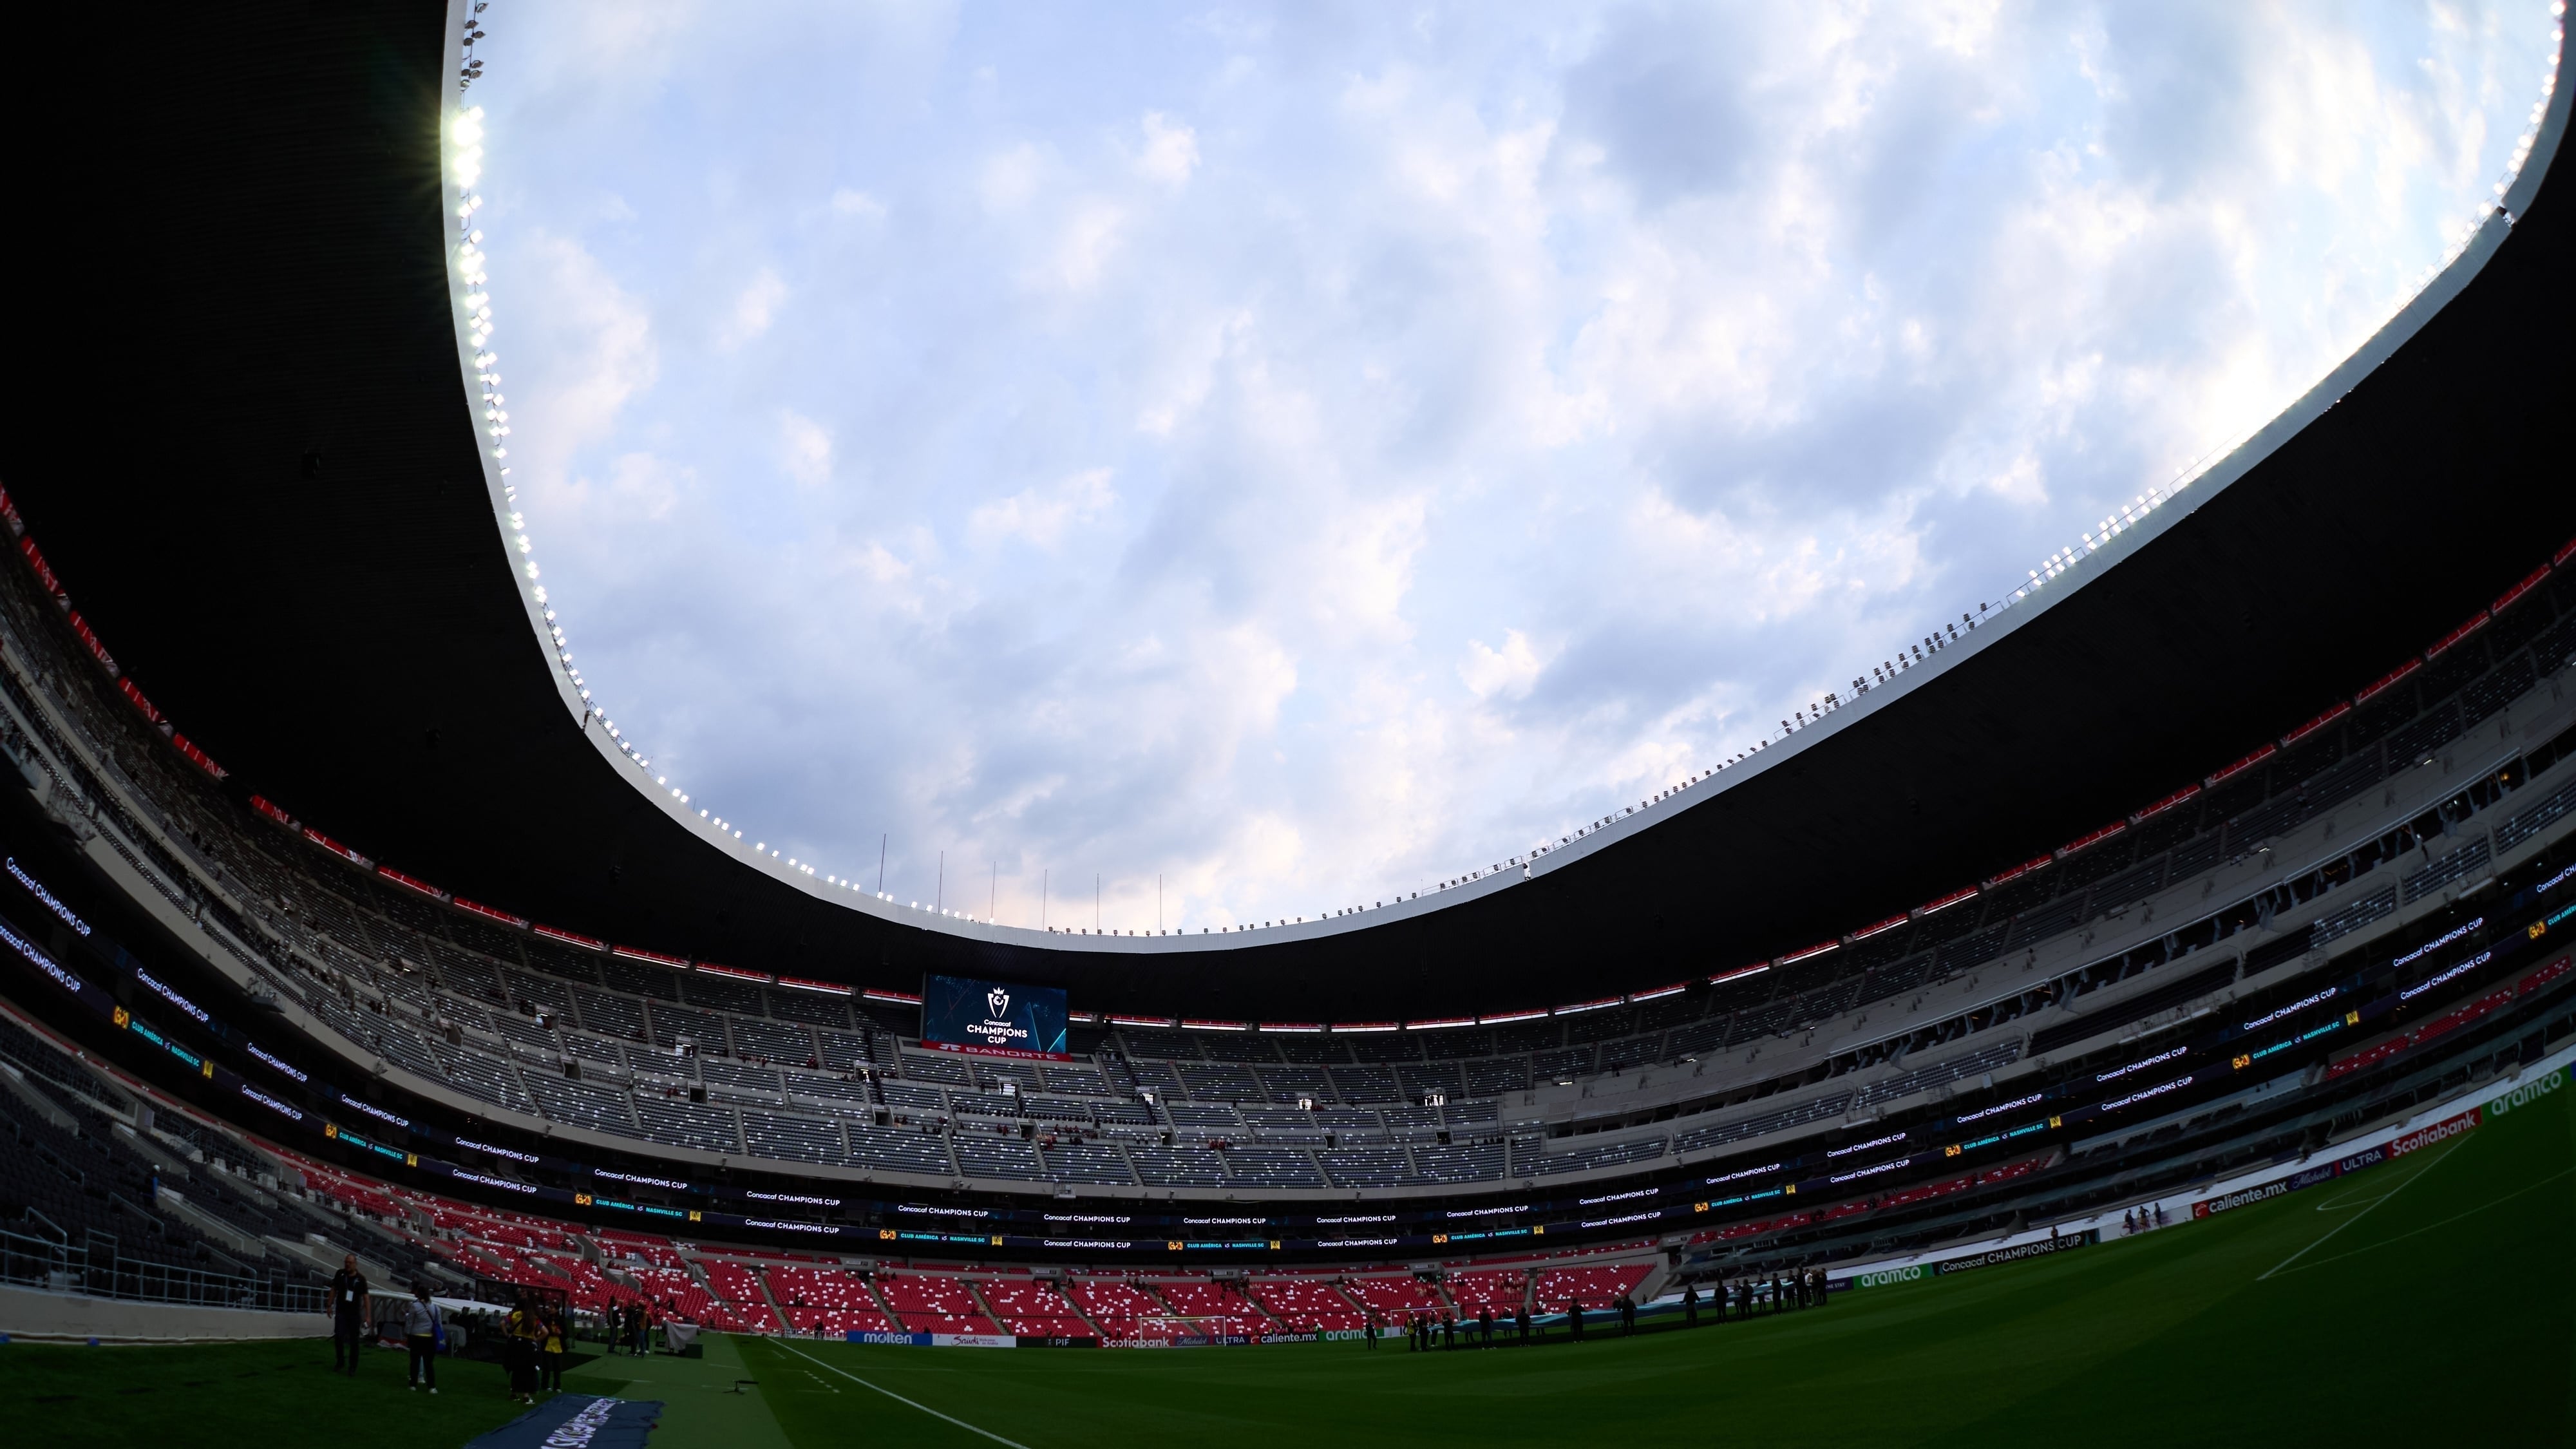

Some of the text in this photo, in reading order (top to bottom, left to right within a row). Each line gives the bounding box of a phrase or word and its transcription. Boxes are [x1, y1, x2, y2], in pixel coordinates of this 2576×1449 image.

[2537, 871, 2564, 893] Concacaf
[7, 857, 91, 936] Concacaf CHAMPIONS CUP
[2548, 914, 2561, 925] CLUB
[2393, 917, 2483, 967] Concacaf CHAMPIONS CUP
[0, 925, 80, 992] oncacaf CHAMPIONS CUP
[2400, 952, 2491, 999] Concacaf CHAMPIONS CUP
[138, 968, 209, 1023] Concacaf CHAMPIONS CUP
[2244, 987, 2336, 1030] Concacaf CHAMPIONS CUP
[967, 1025, 1028, 1038] CHAMPIONS
[983, 1019, 1011, 1027] Concacaf
[132, 1021, 144, 1034] CLUB
[171, 1045, 193, 1063] NASHVILLE
[193, 1058, 200, 1066] SC
[987, 1036, 1007, 1044] CUP
[2253, 1050, 2268, 1059] CLUB
[2303, 1025, 2332, 1040] NASHVILLE
[248, 1042, 307, 1082] Concacaf CHAMPIONS CUP
[966, 1047, 1057, 1060] BANORTE
[2096, 1046, 2187, 1082] Concacaf CHAMPIONS CUP
[242, 1084, 302, 1121] Concacaf CHAMPIONS CUP
[2101, 1076, 2192, 1111] Concacaf CHAMPIONS CUP
[2492, 1072, 2562, 1115] aramco
[342, 1094, 409, 1127] Concacaf CHAMPIONS CUP
[1957, 1094, 2041, 1123] Concacaf CHAMPIONS CUP
[2009, 1126, 2036, 1137] NASHVILLE
[2392, 1112, 2476, 1156] Scotiabank
[456, 1137, 539, 1163] Concacaf CHAMPIONS CUP
[1827, 1132, 1906, 1157] Concacaf CHAMPIONS CUP
[1830, 1159, 1909, 1183] Concacaf CHAMPIONS CUP
[2343, 1150, 2382, 1171] ULTRA
[453, 1169, 537, 1193] Concacaf CHAMPIONS CUP
[594, 1169, 625, 1179] Concacaf
[625, 1174, 670, 1187] CHAMPIONS
[1706, 1174, 1730, 1184] Concacaf
[1731, 1166, 1766, 1179] CHAMPIONS
[746, 1191, 777, 1200] Concacaf
[778, 1194, 823, 1204] CHAMPIONS
[1579, 1196, 1605, 1205] Concacaf
[1606, 1190, 1644, 1201] CHAMPIONS
[2209, 1181, 2287, 1213] caliente.mx
[646, 1207, 674, 1216] NASHVILLE
[929, 1208, 972, 1216] CHAMPIONS
[1474, 1207, 1513, 1215] CHAMPIONS
[1581, 1219, 1607, 1227] Concacaf
[1608, 1214, 1647, 1224] CHAMPIONS
[745, 1218, 776, 1227] Concacaf
[777, 1222, 822, 1233] CHAMPIONS
[1942, 1235, 2081, 1271] Concacaf CHAMPIONS CUP
[1861, 1266, 1920, 1287] aramco
[864, 1332, 912, 1344] molten
[1103, 1336, 1169, 1348] Scotiabank
[1261, 1333, 1316, 1343] caliente.mx
